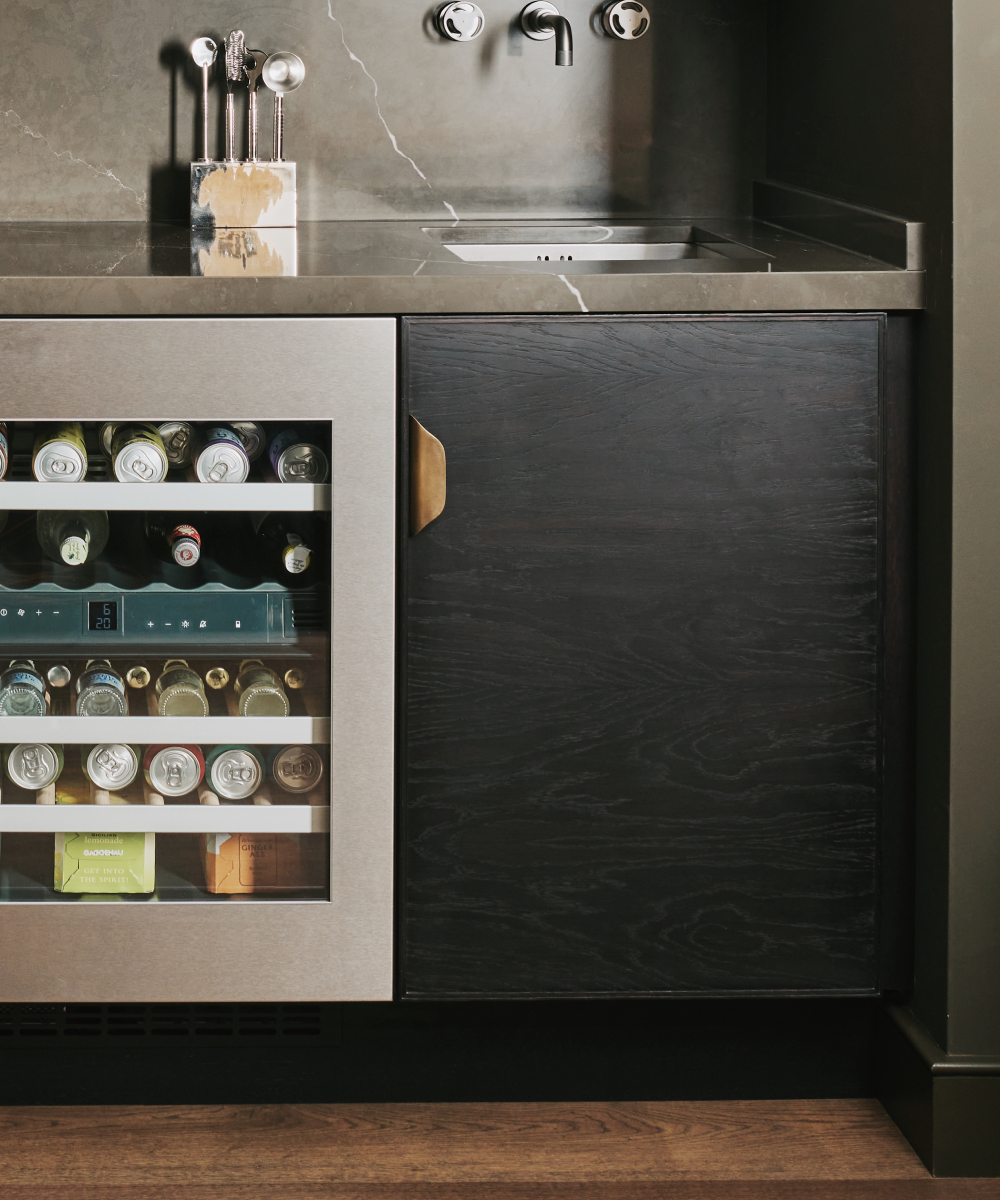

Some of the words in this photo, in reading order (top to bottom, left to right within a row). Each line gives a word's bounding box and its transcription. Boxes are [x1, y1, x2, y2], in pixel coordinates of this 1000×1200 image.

[103, 603, 111, 616] 6
[96, 617, 111, 629] 20
[85, 836, 124, 844] lemonade
